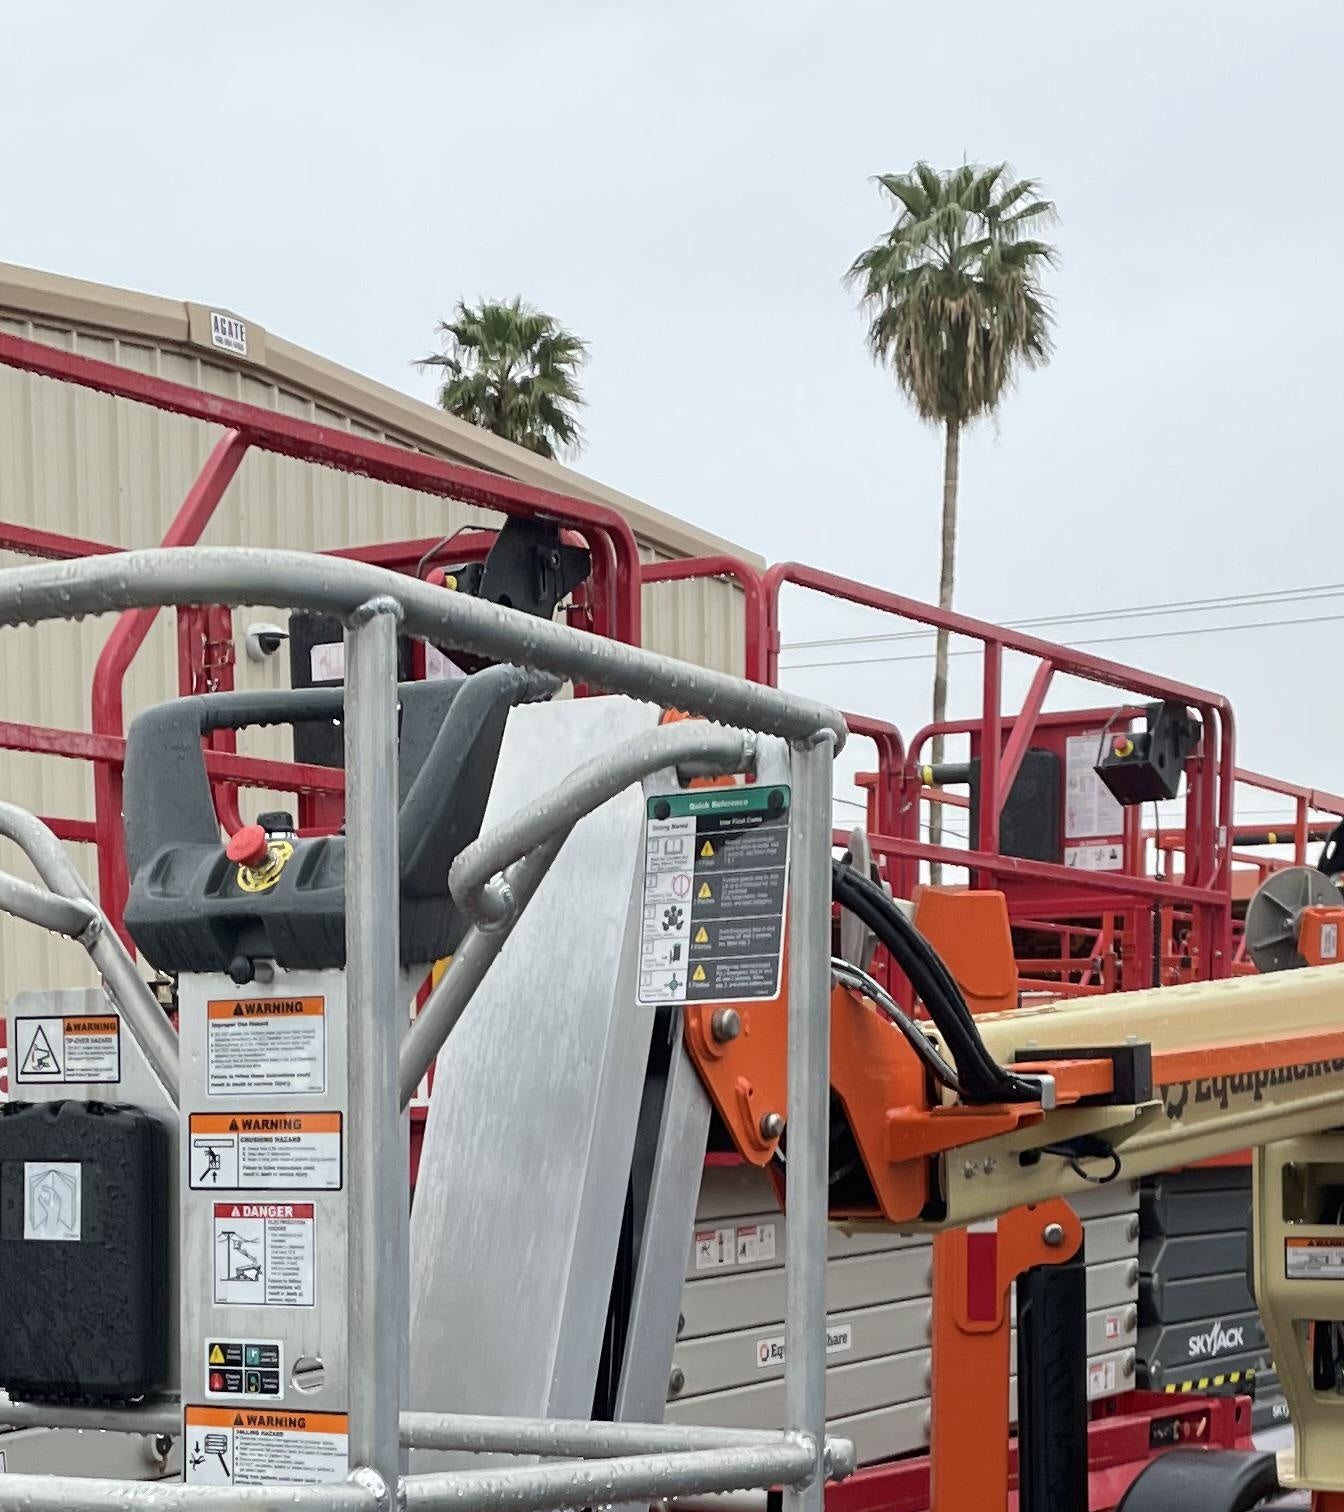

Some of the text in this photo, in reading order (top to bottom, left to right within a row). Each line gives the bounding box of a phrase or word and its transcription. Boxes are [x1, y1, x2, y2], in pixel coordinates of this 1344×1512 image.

[213, 315, 245, 342] AGATE
[244, 1001, 304, 1014] WARNING
[74, 1022, 116, 1032] WARNING
[241, 1119, 302, 1130] WARNING
[242, 1206, 293, 1218] DANGER
[1188, 1321, 1244, 1356] SKYJACK
[246, 1415, 306, 1428] WARNING
